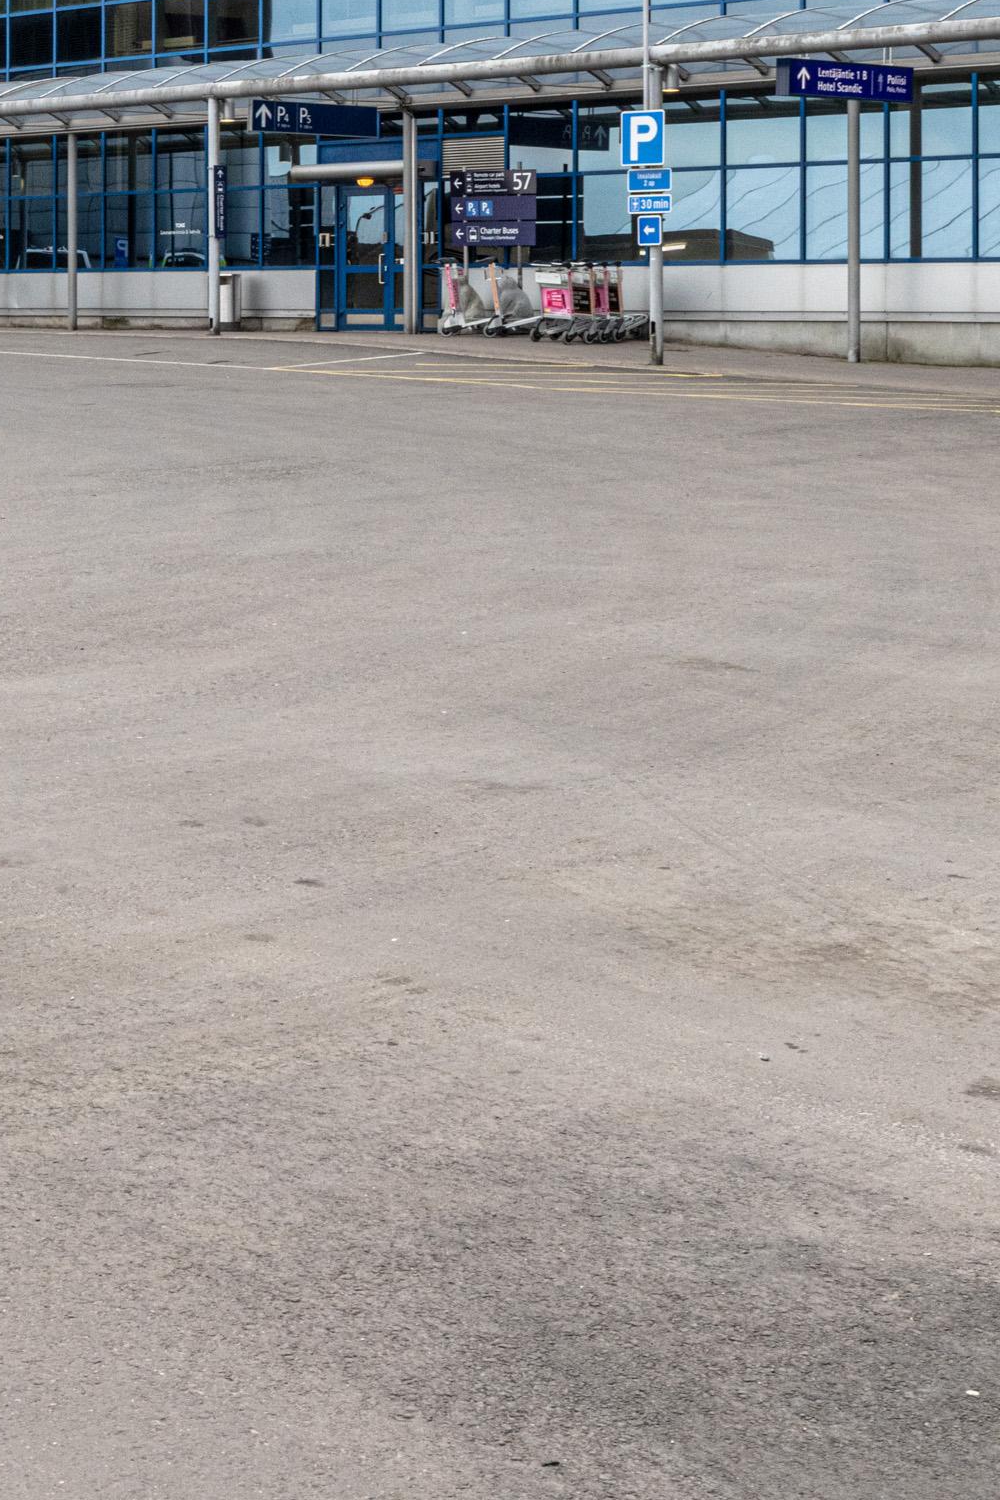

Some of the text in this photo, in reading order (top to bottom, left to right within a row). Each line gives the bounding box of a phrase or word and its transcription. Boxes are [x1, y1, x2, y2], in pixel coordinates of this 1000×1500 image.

[862, 70, 868, 80] B
[817, 81, 863, 94] Hotel Scandic
[630, 115, 658, 161] P
[512, 172, 532, 190] 57
[640, 198, 669, 210] 30 min
[480, 226, 519, 235] Charter Buses
